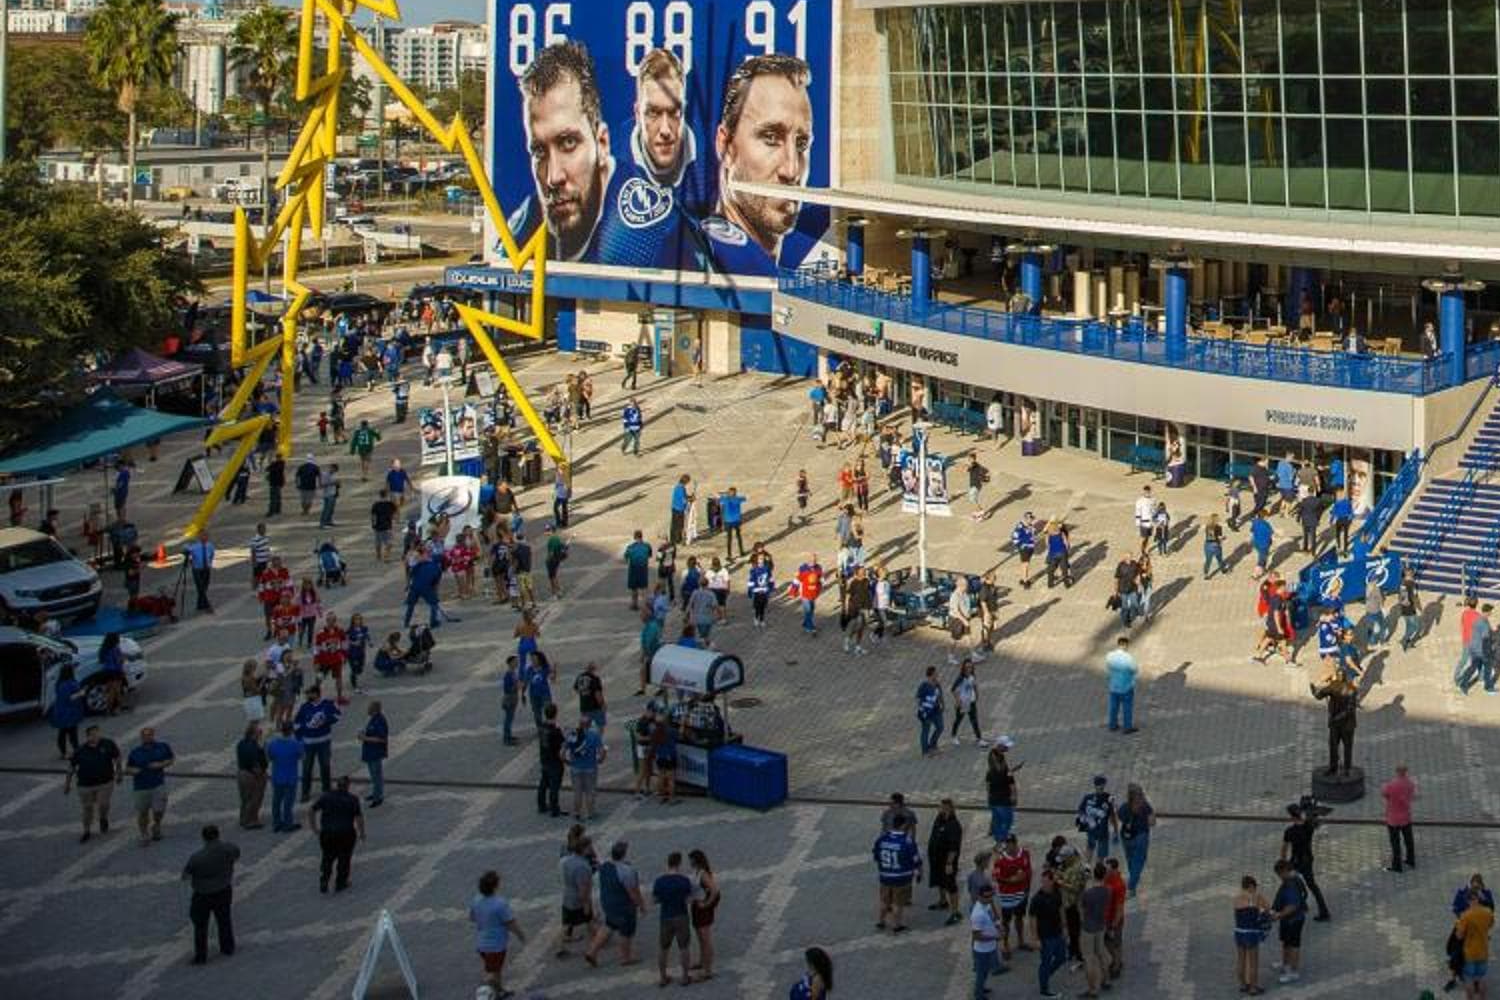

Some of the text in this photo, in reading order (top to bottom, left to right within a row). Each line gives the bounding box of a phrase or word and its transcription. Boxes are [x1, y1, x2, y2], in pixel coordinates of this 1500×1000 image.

[625, 0, 694, 78] 88
[918, 346, 960, 367] OFFICE
[880, 849, 899, 869] 91
